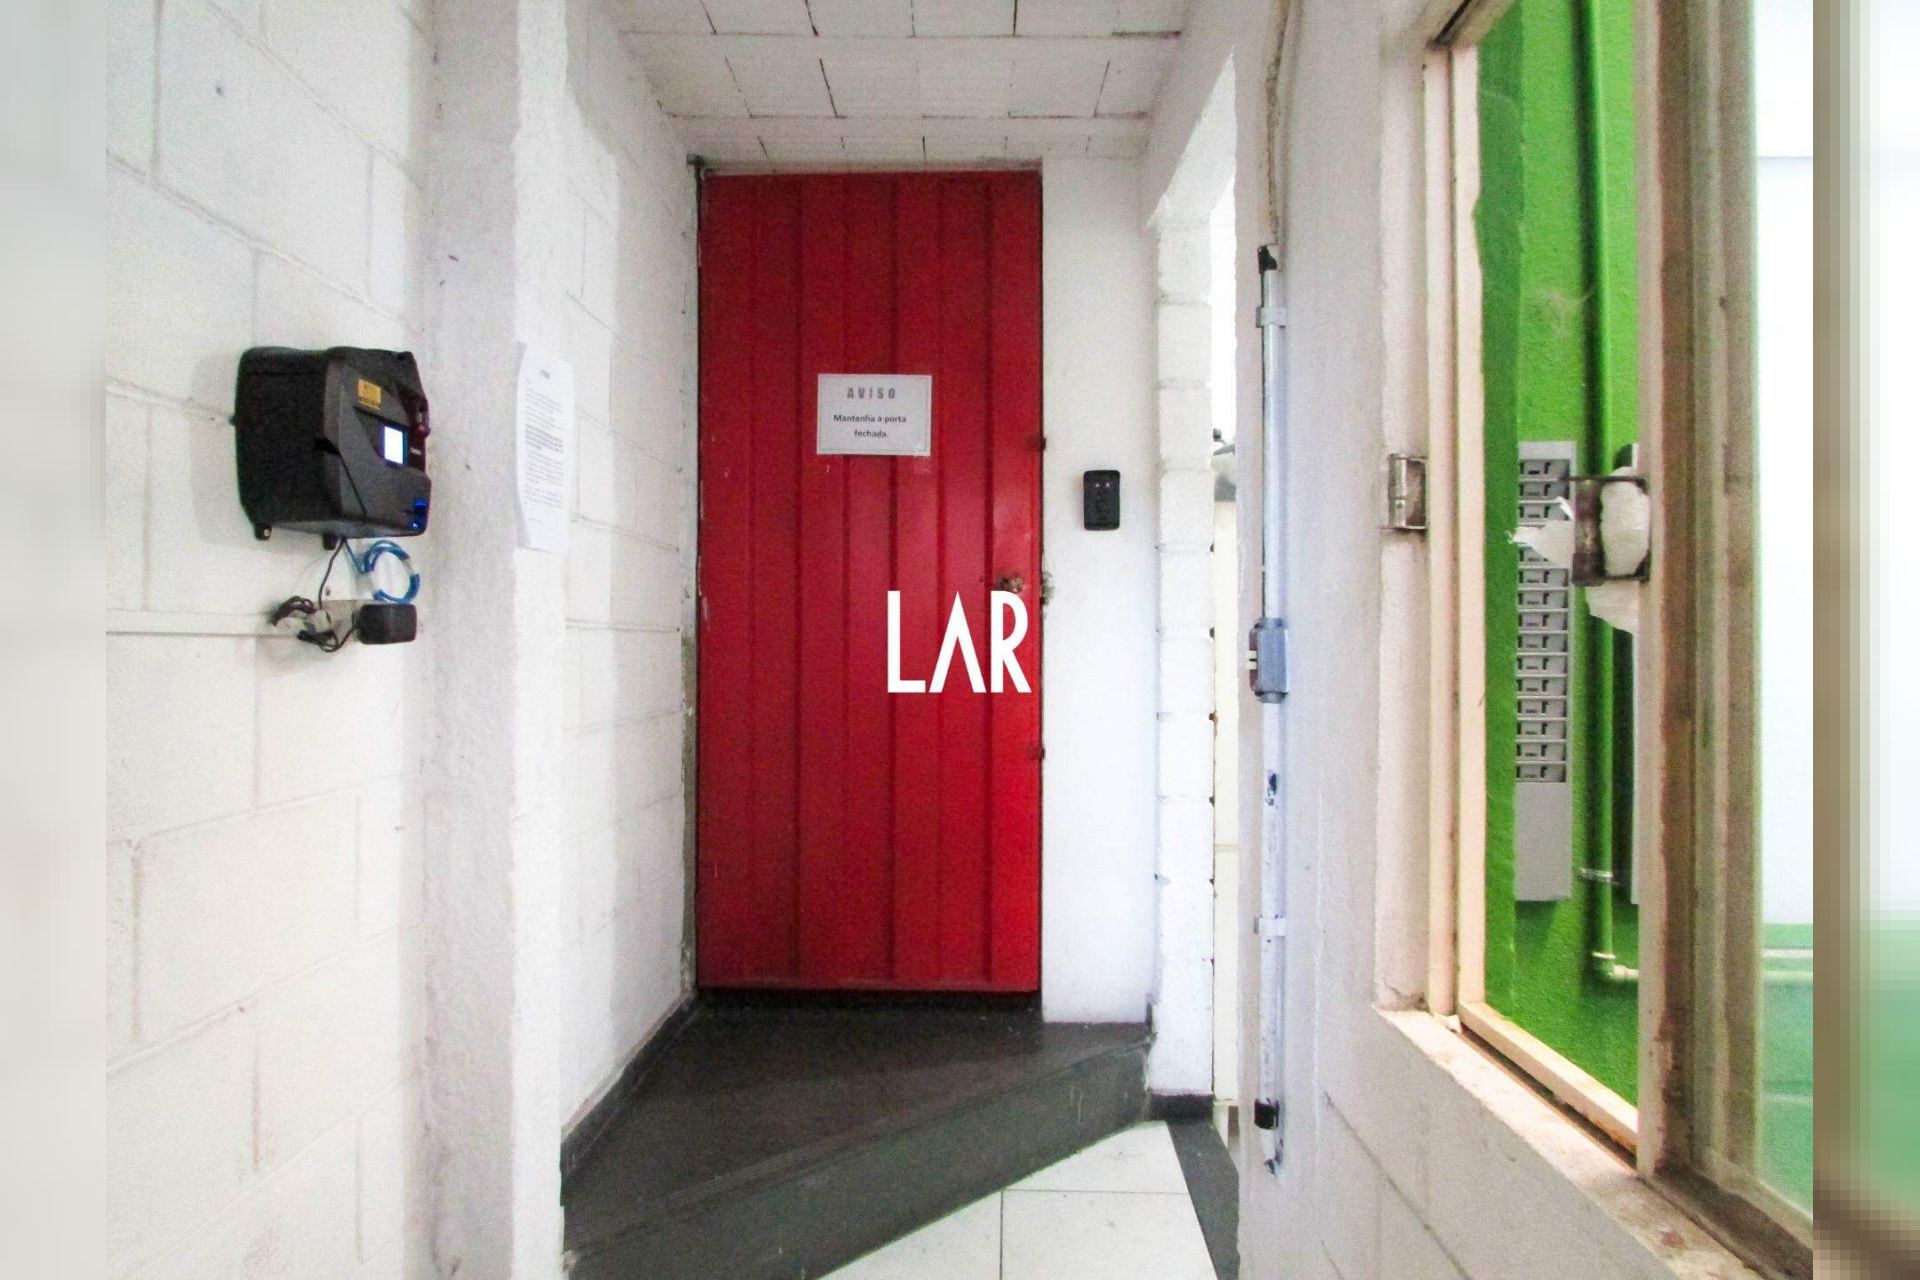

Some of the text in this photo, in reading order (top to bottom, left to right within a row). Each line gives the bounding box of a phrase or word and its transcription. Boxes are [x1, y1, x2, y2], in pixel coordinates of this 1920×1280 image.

[847, 387, 896, 399] AVISO
[833, 414, 875, 422] Mantenha
[884, 416, 907, 424] porta
[854, 429, 889, 438] fechada.
